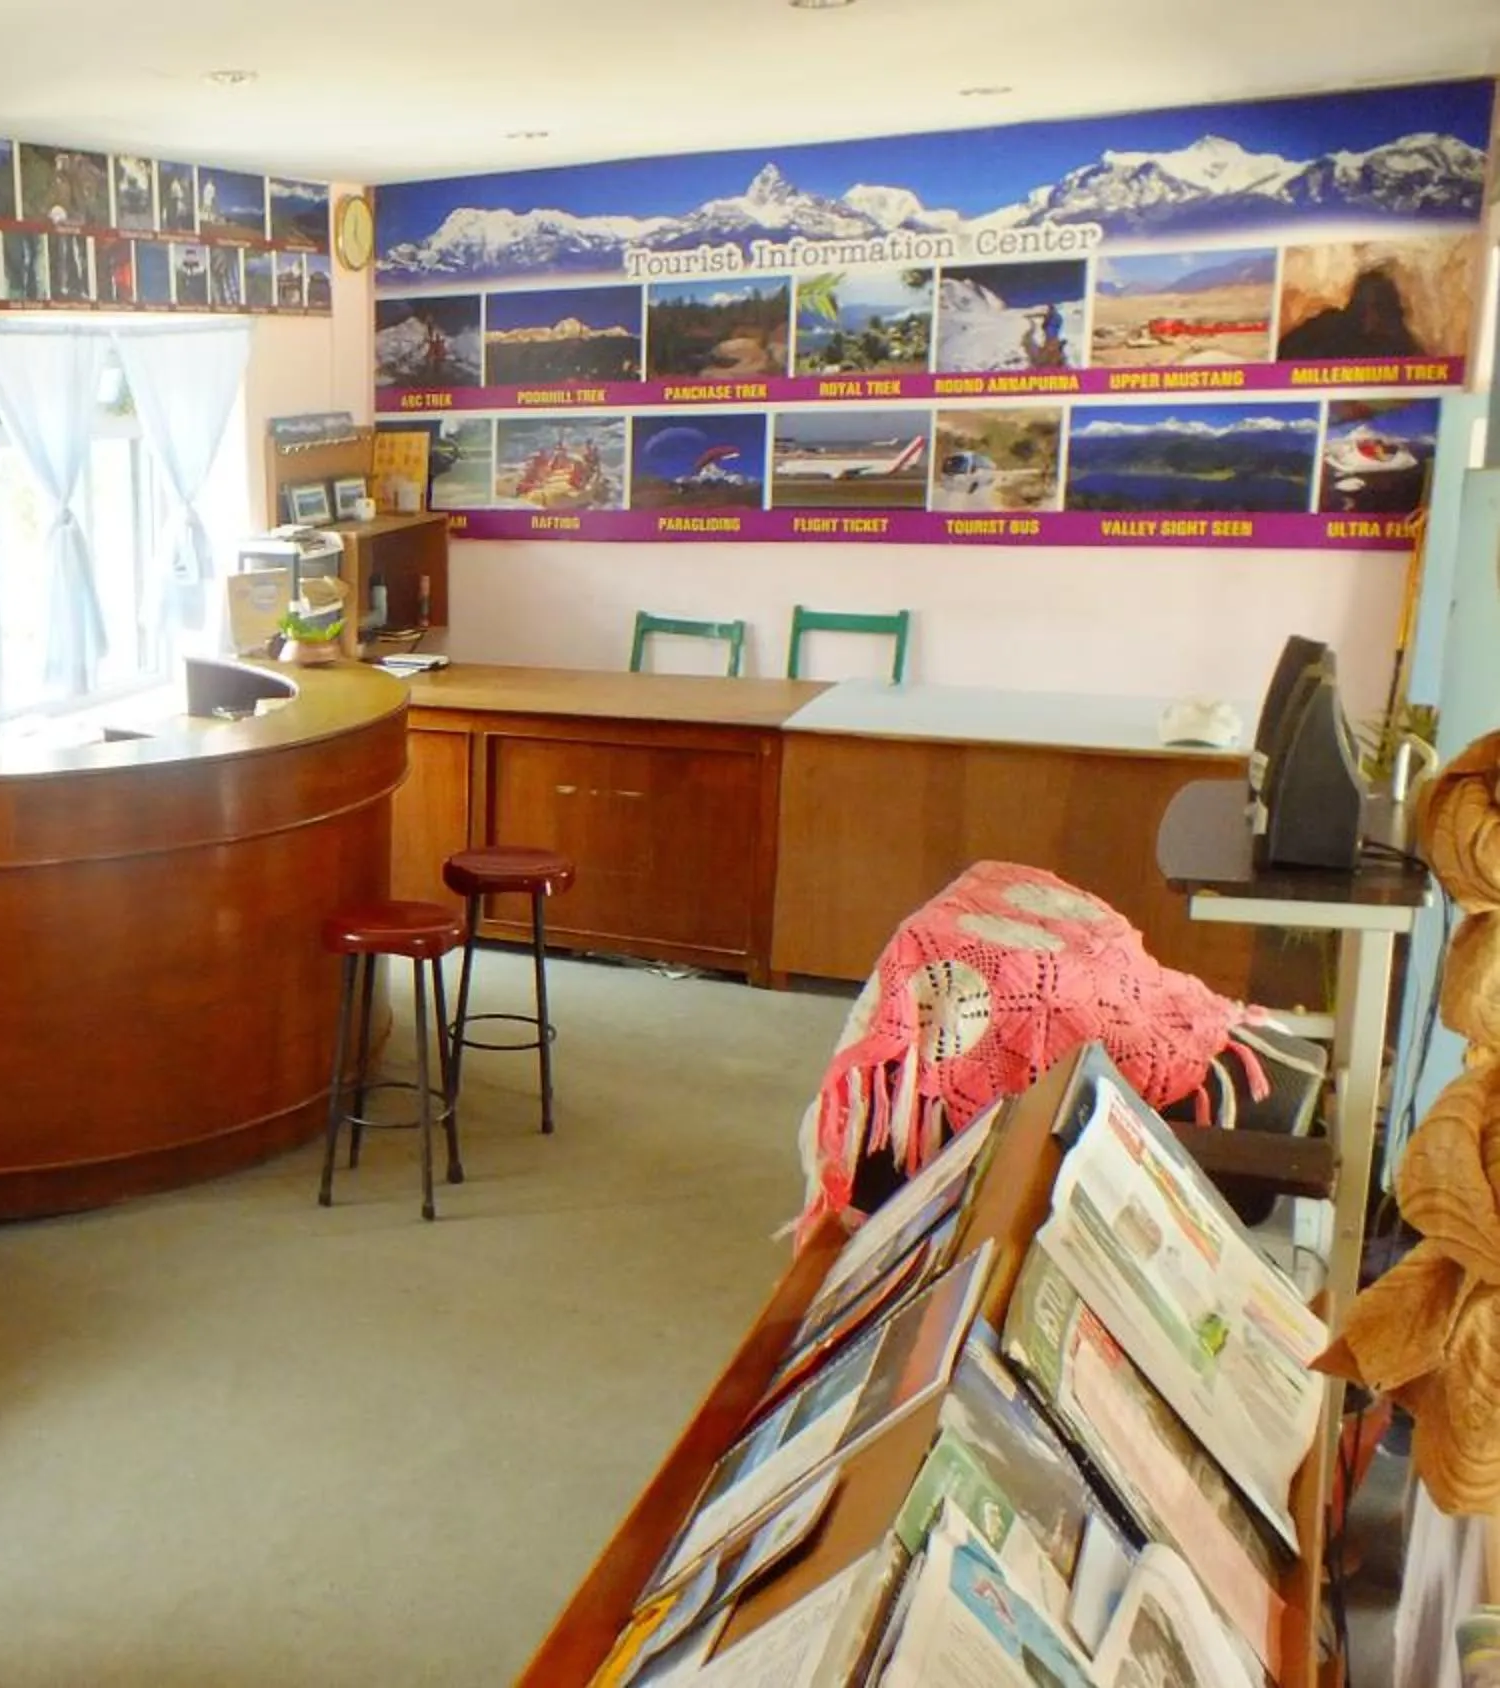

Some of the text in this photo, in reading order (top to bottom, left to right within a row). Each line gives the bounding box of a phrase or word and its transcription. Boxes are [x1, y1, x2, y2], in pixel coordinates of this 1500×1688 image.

[628, 226, 1098, 278] Tourist Information Center
[1109, 369, 1245, 390] UPPER MUSTANG
[1290, 363, 1449, 385] MILLENNIUM TREK
[664, 383, 767, 401] PANCHASE TREK
[819, 380, 901, 397] ROYAL TREK
[934, 374, 1080, 394] ROUND ANNAPURNA
[426, 393, 452, 407] TREK
[577, 389, 607, 404] TREK
[450, 514, 467, 529] ARI
[531, 515, 581, 530] RAFTING
[658, 516, 741, 532] PARAGLIDING
[794, 517, 889, 533] FLIGHT TICKET
[945, 519, 1040, 535] TOURIST BUS
[1101, 520, 1252, 537] VALLEY SIGHT SEEN
[1327, 521, 1380, 538] ULTRA
